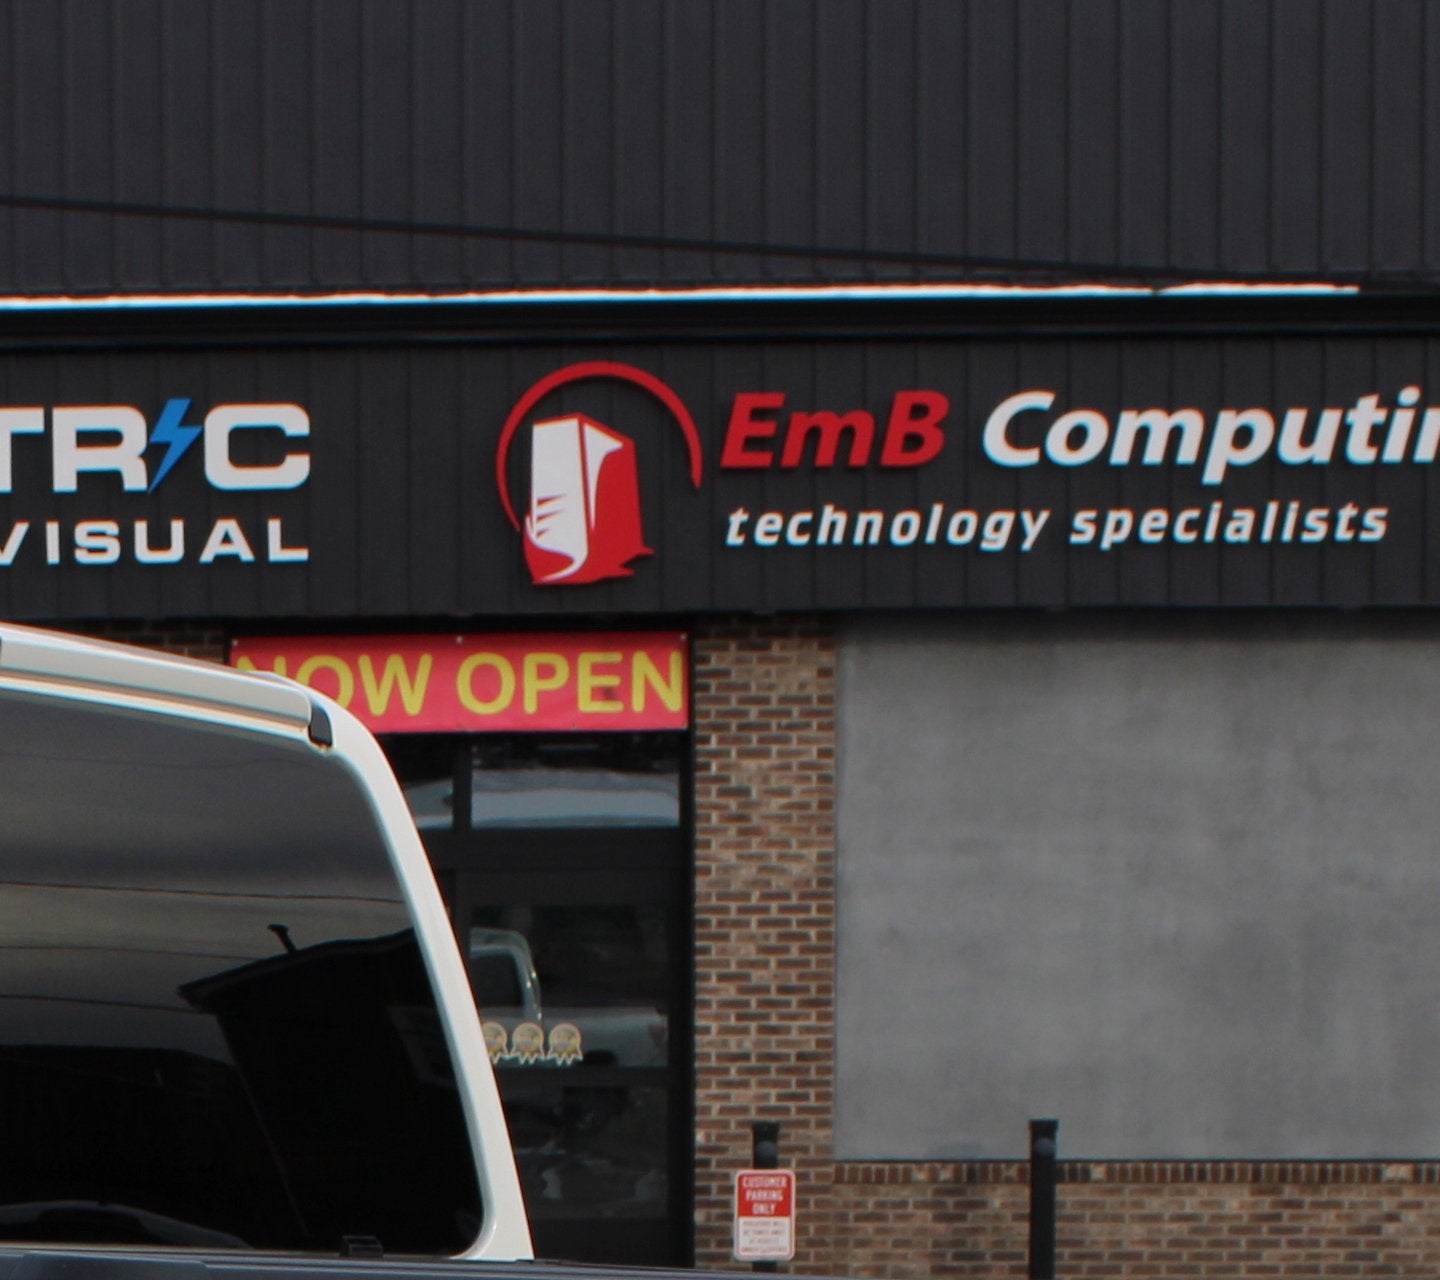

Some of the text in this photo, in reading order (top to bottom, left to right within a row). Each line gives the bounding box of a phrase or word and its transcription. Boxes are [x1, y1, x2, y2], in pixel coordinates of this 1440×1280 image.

[719, 389, 950, 469] EmB
[725, 500, 1390, 554] technology specialists
[455, 651, 683, 715] OPEN
